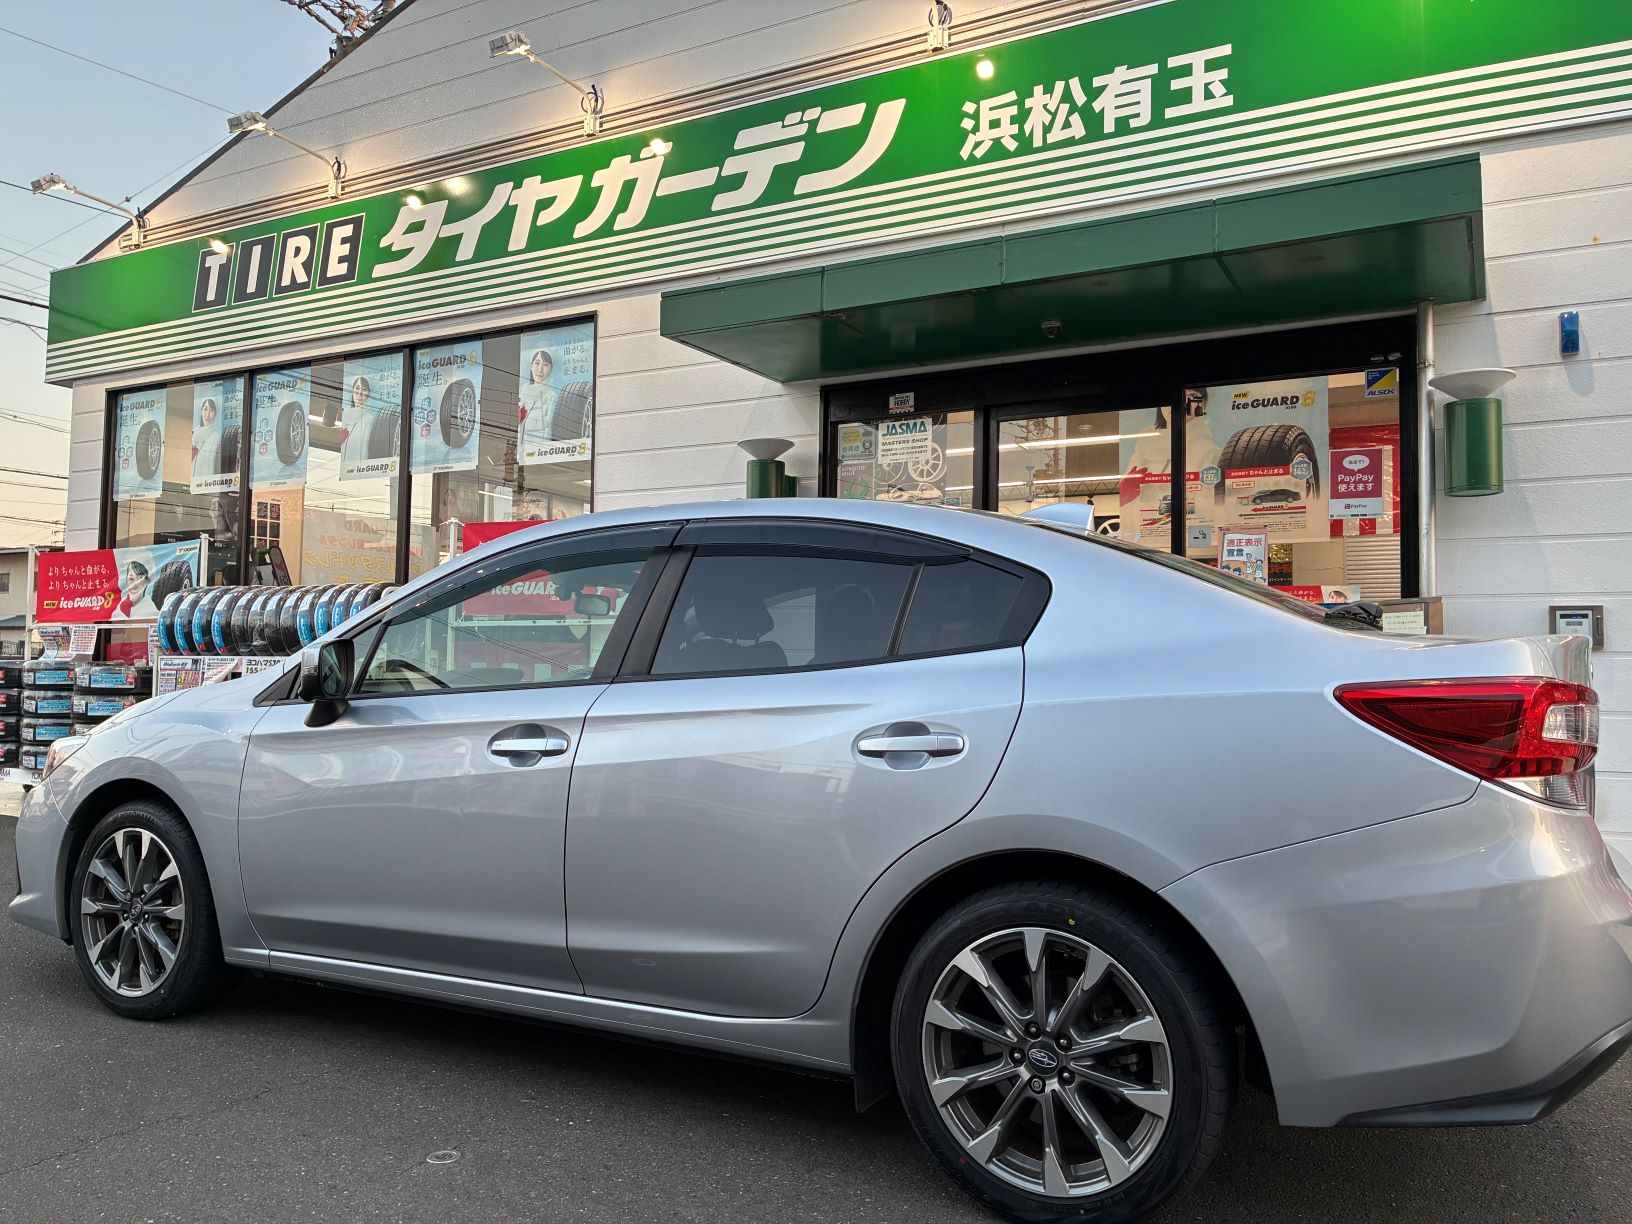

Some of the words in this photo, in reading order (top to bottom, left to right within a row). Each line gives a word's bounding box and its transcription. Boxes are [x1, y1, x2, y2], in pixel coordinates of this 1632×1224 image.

[204, 223, 355, 302] TIRE
[371, 97, 906, 279] タイヤガーデン
[959, 43, 1234, 161] 浜松有玉
[418, 353, 467, 370] iceGUARD
[1231, 395, 1300, 411] iceGUARD
[881, 420, 928, 437] JASMA
[537, 445, 577, 457] iceGUARD
[356, 463, 389, 473] iceGUARD
[1337, 473, 1374, 483] PayPay
[1337, 482, 1375, 493] 使えます
[491, 581, 560, 596] iceGUAR
[59, 595, 105, 609] iceGUARD
